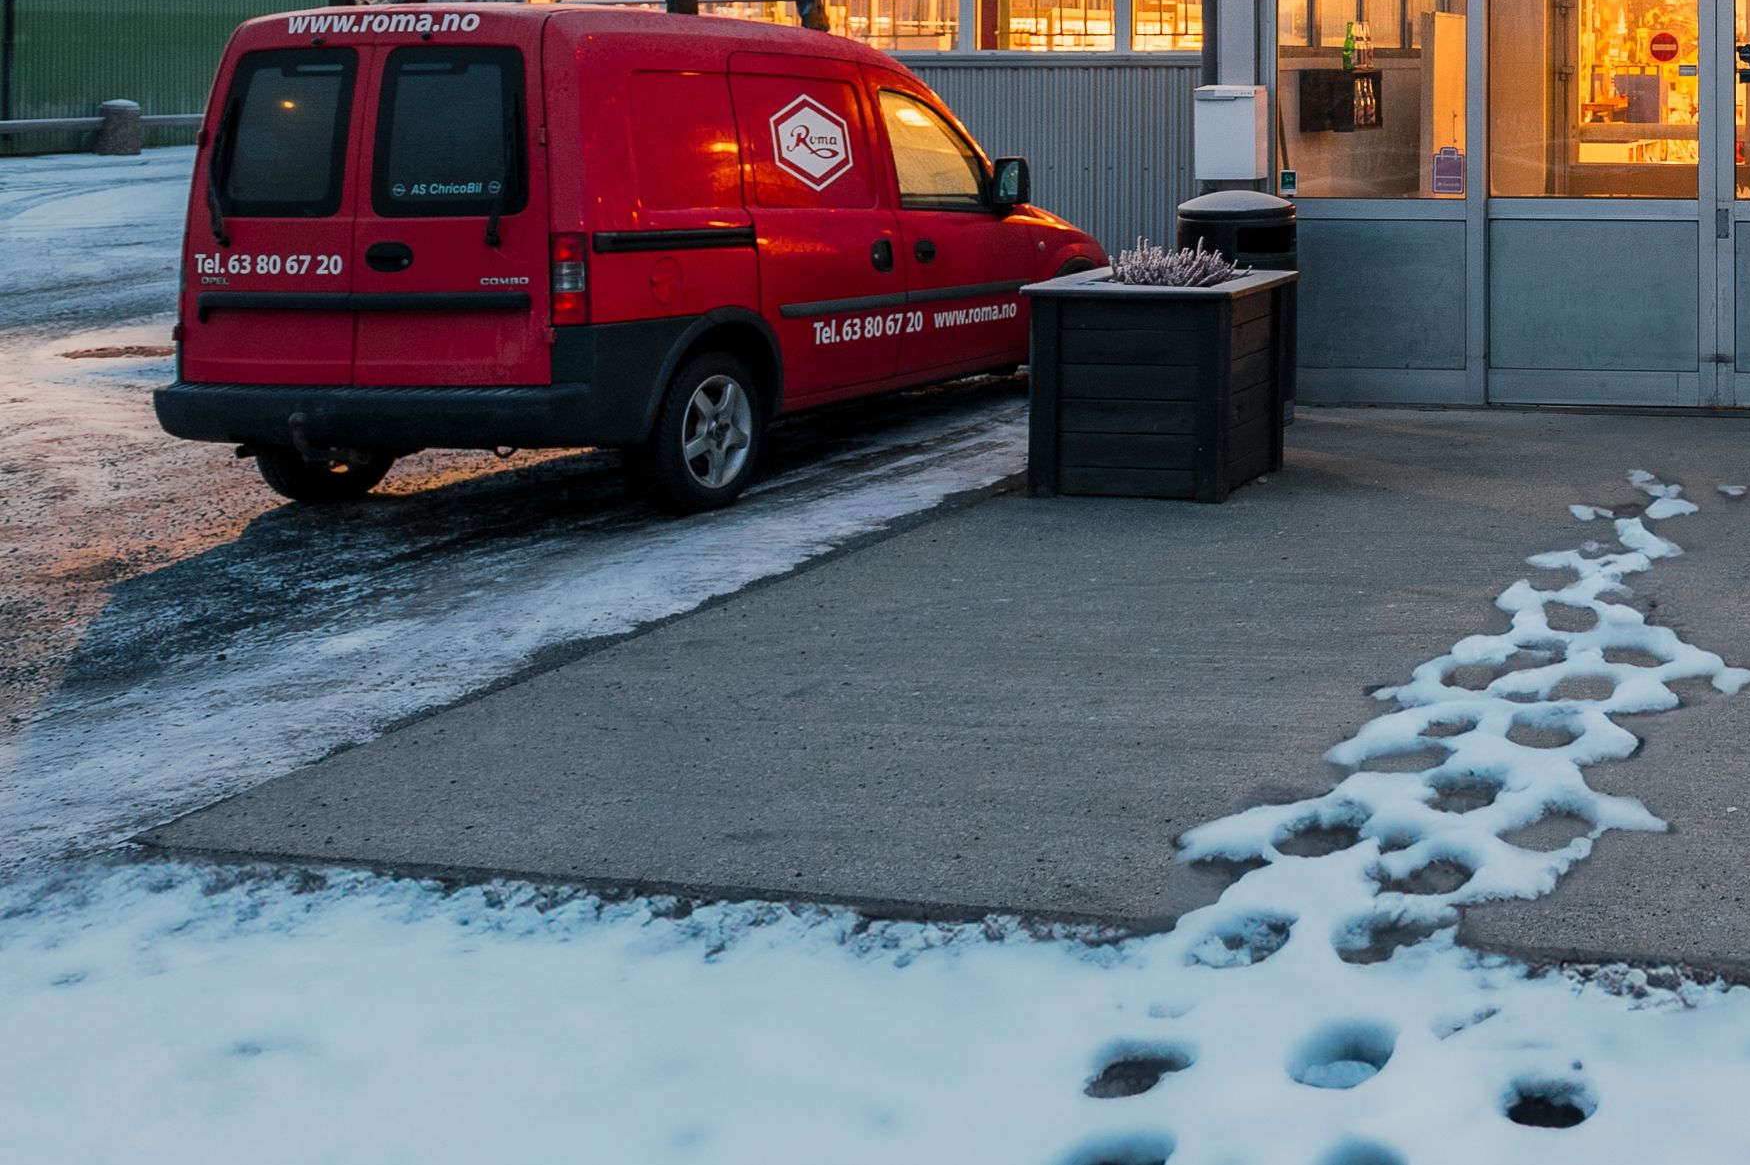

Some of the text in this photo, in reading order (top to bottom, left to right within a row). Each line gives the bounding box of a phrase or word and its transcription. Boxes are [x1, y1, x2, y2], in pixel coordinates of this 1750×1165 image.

[288, 13, 481, 34] www.roma.no
[786, 124, 839, 159] Roma
[410, 183, 427, 195] AS
[194, 252, 343, 275] Tel. 63 80 67 20
[201, 276, 230, 285] OPEL
[480, 277, 530, 285] COMBO
[813, 302, 1017, 345] Tel. 63 80 67 20 www.roma.no
